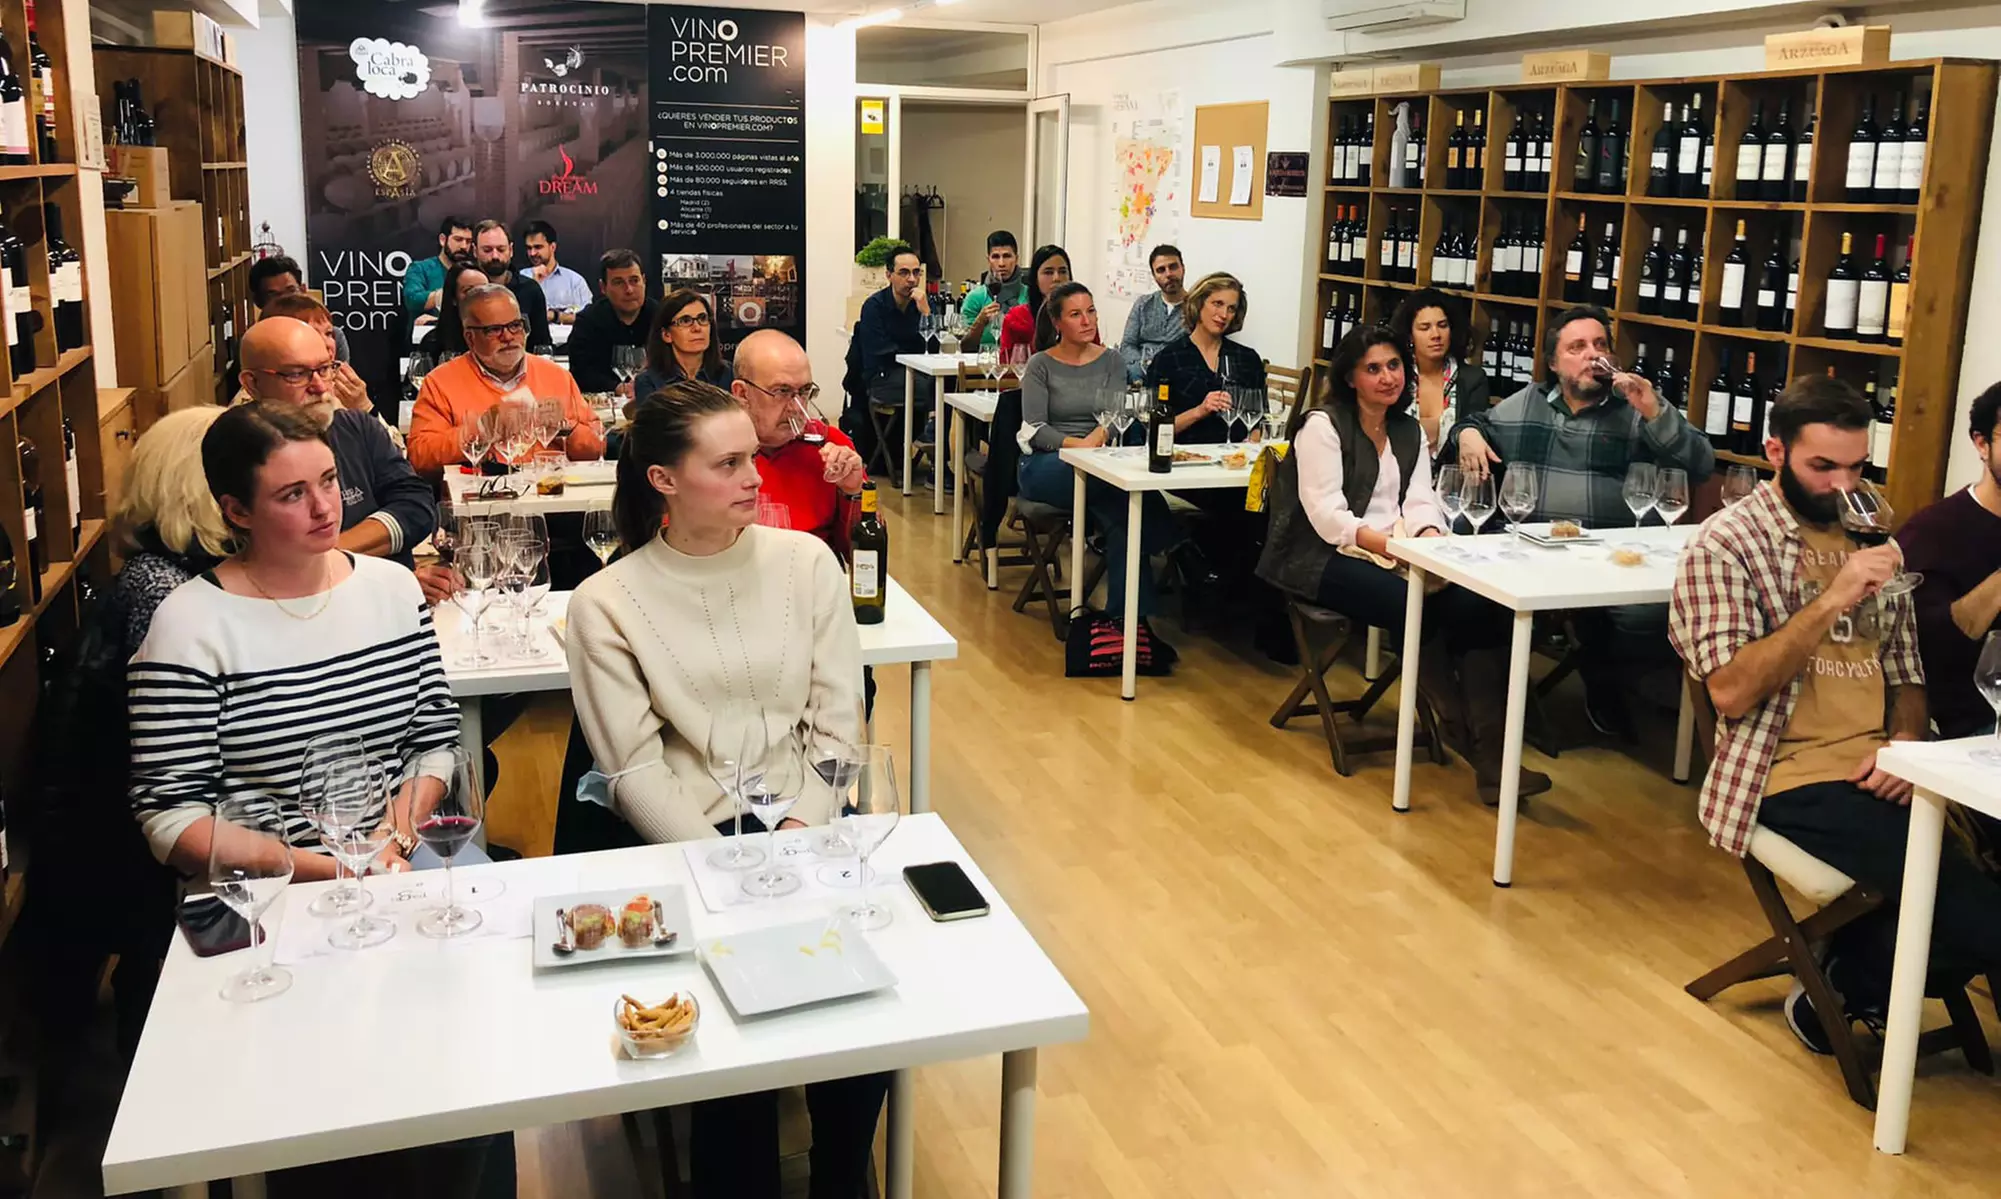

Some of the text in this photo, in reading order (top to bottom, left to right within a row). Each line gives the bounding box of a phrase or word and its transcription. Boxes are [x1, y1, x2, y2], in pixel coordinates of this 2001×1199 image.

[670, 16, 738, 42] VINO
[370, 52, 414, 67] Cabra
[672, 40, 788, 67] PREMIER
[367, 61, 396, 76] loca
[668, 65, 728, 84] .com
[520, 82, 610, 96] PATROCINIO
[657, 112, 799, 124] ¿QUIERES VENDER TUS PRODUCTOS
[684, 121, 774, 132] EN VINOPREMIER.COM?
[732, 152, 758, 162] páginas
[538, 180, 598, 194] DREAM
[722, 178, 758, 186] seguidores
[706, 222, 750, 230] profesionales
[320, 250, 412, 276] VINO
